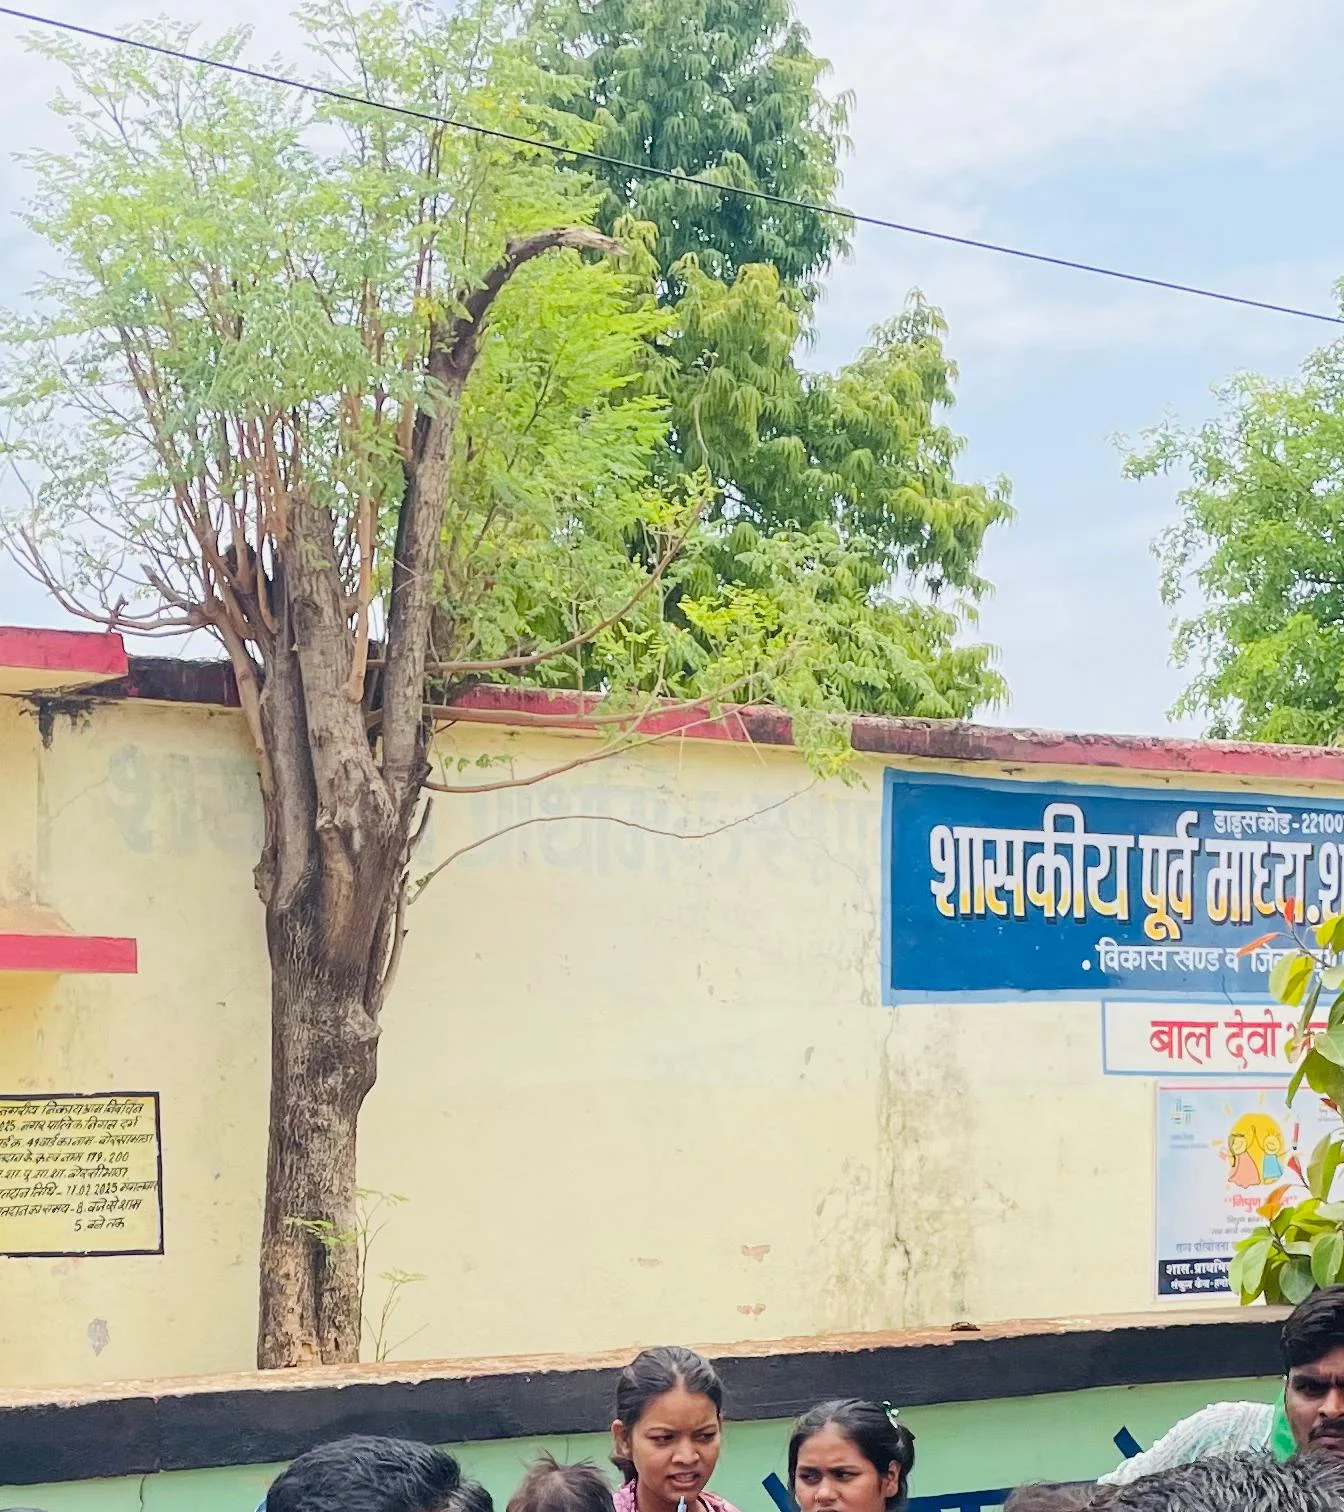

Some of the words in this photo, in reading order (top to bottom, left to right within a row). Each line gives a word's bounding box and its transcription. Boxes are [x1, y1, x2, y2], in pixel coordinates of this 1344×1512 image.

[929, 802, 1135, 922] शासकीय
[1138, 810, 1200, 941] पूर्व
[1094, 936, 1169, 973] विकास
[1149, 1019, 1219, 1065] बाल
[1224, 1008, 1283, 1070] देवो
